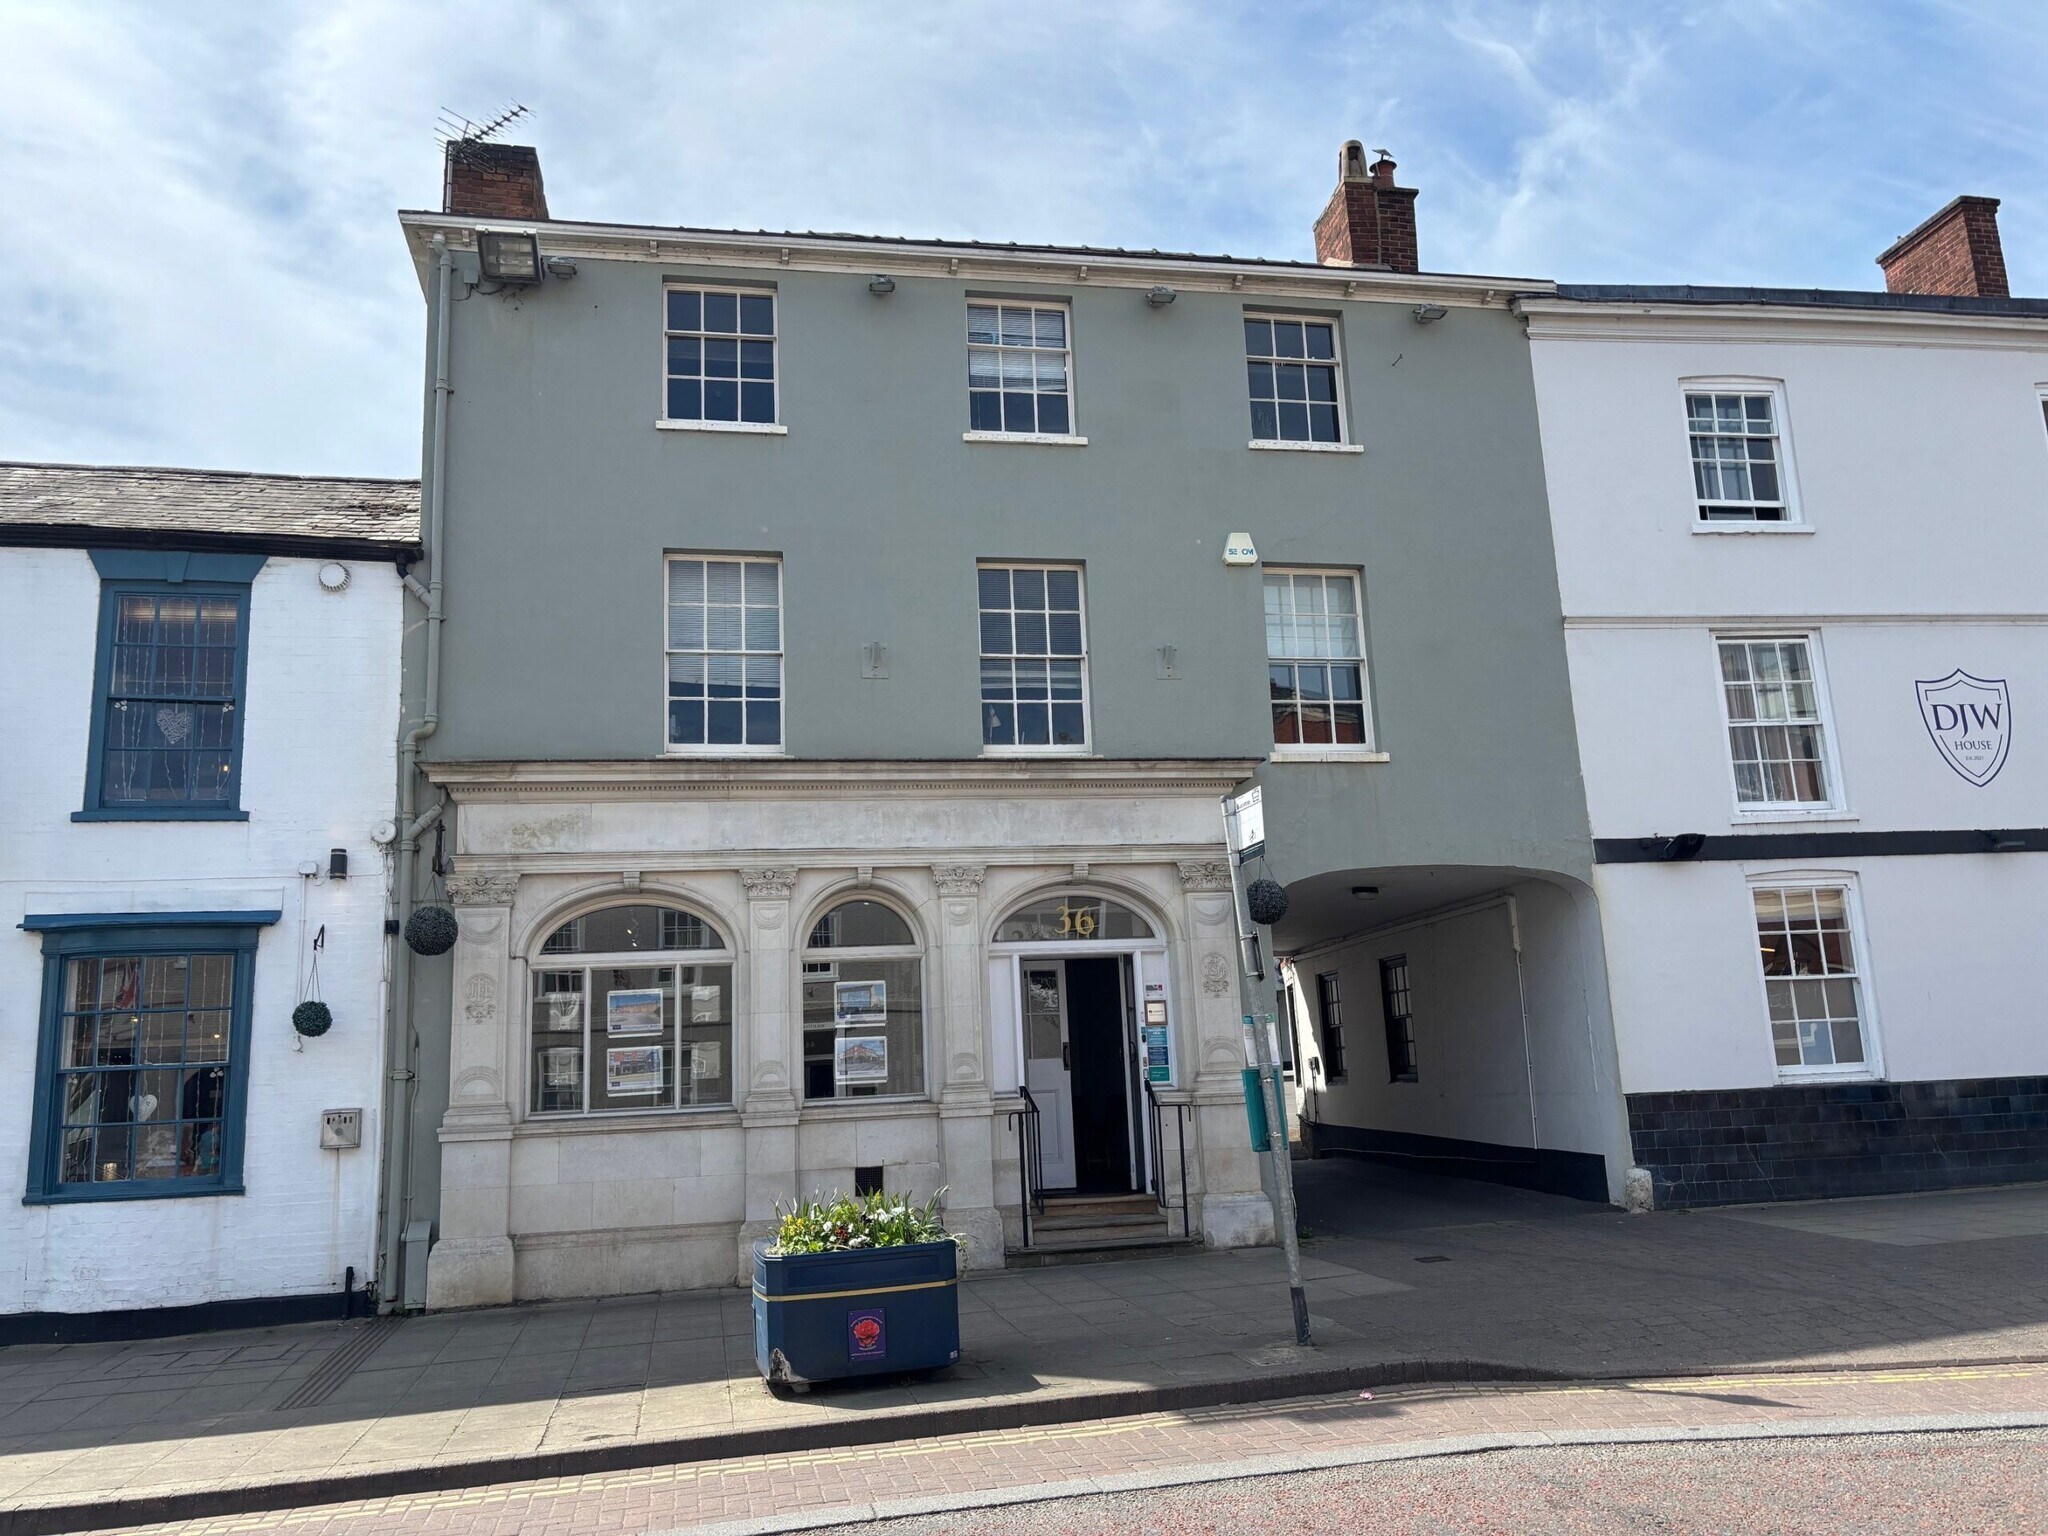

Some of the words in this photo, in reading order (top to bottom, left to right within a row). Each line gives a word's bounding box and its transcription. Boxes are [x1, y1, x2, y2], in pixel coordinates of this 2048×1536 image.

[1228, 548, 1254, 556] SEOM
[1931, 703, 2002, 738] DJW
[1954, 740, 1993, 751] HOUSE
[1055, 905, 1095, 935] 36
